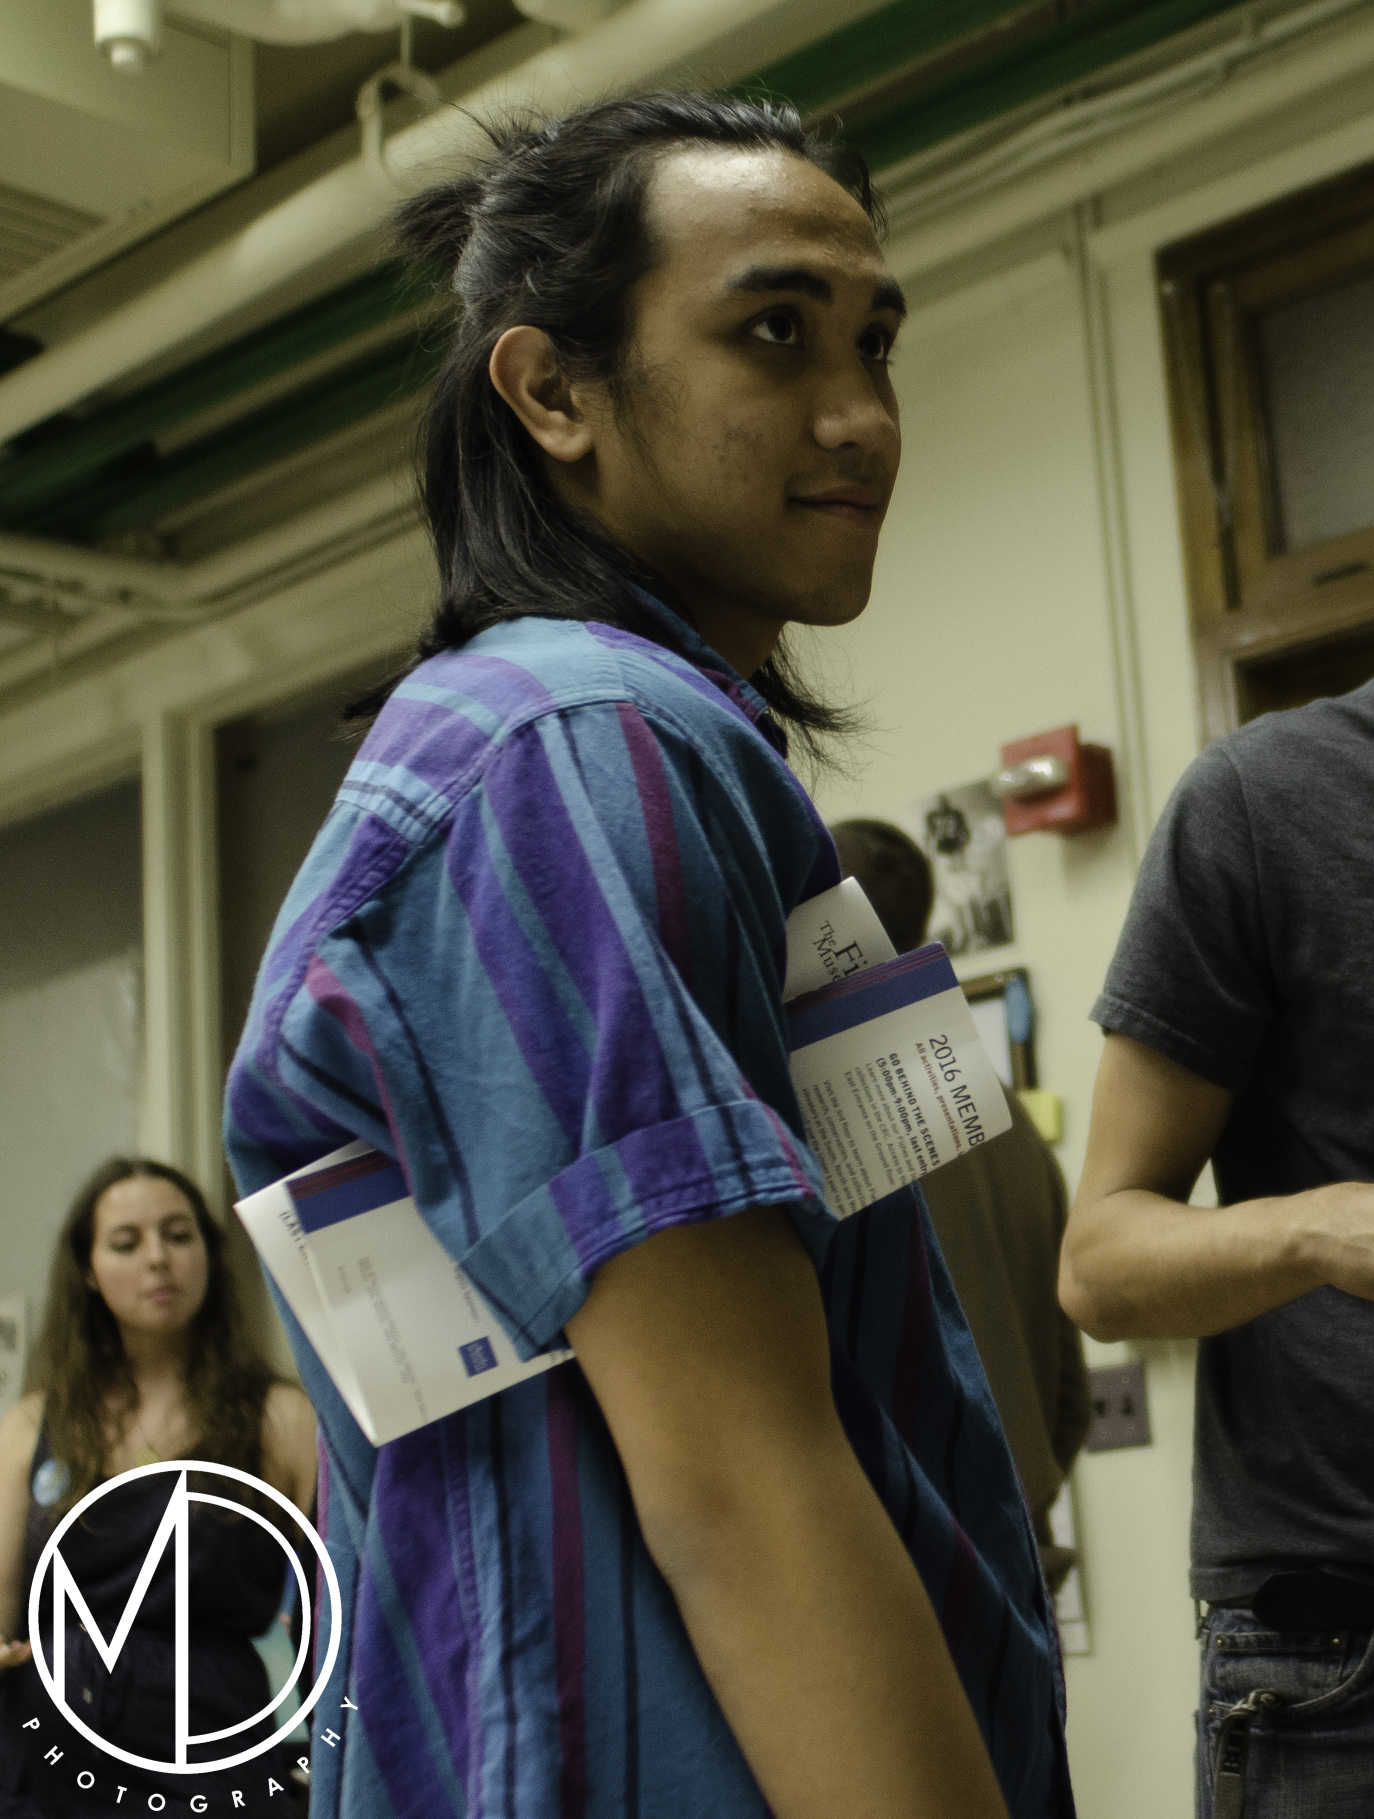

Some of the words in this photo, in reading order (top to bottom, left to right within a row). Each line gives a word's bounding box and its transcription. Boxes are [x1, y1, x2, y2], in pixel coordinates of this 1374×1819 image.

[819, 919, 836, 949] The
[915, 1042, 925, 1053] All
[919, 1054, 939, 1093] activities,
[928, 1033, 960, 1082] 2016
[952, 1085, 986, 1146] MEMB
[888, 1052, 900, 1066] GO
[895, 1067, 916, 1105] BEHIND
[912, 1106, 925, 1125] THE
[921, 1127, 940, 1166] SCENES
[937, 1095, 962, 1152] presentations,
[910, 1136, 922, 1153] last
